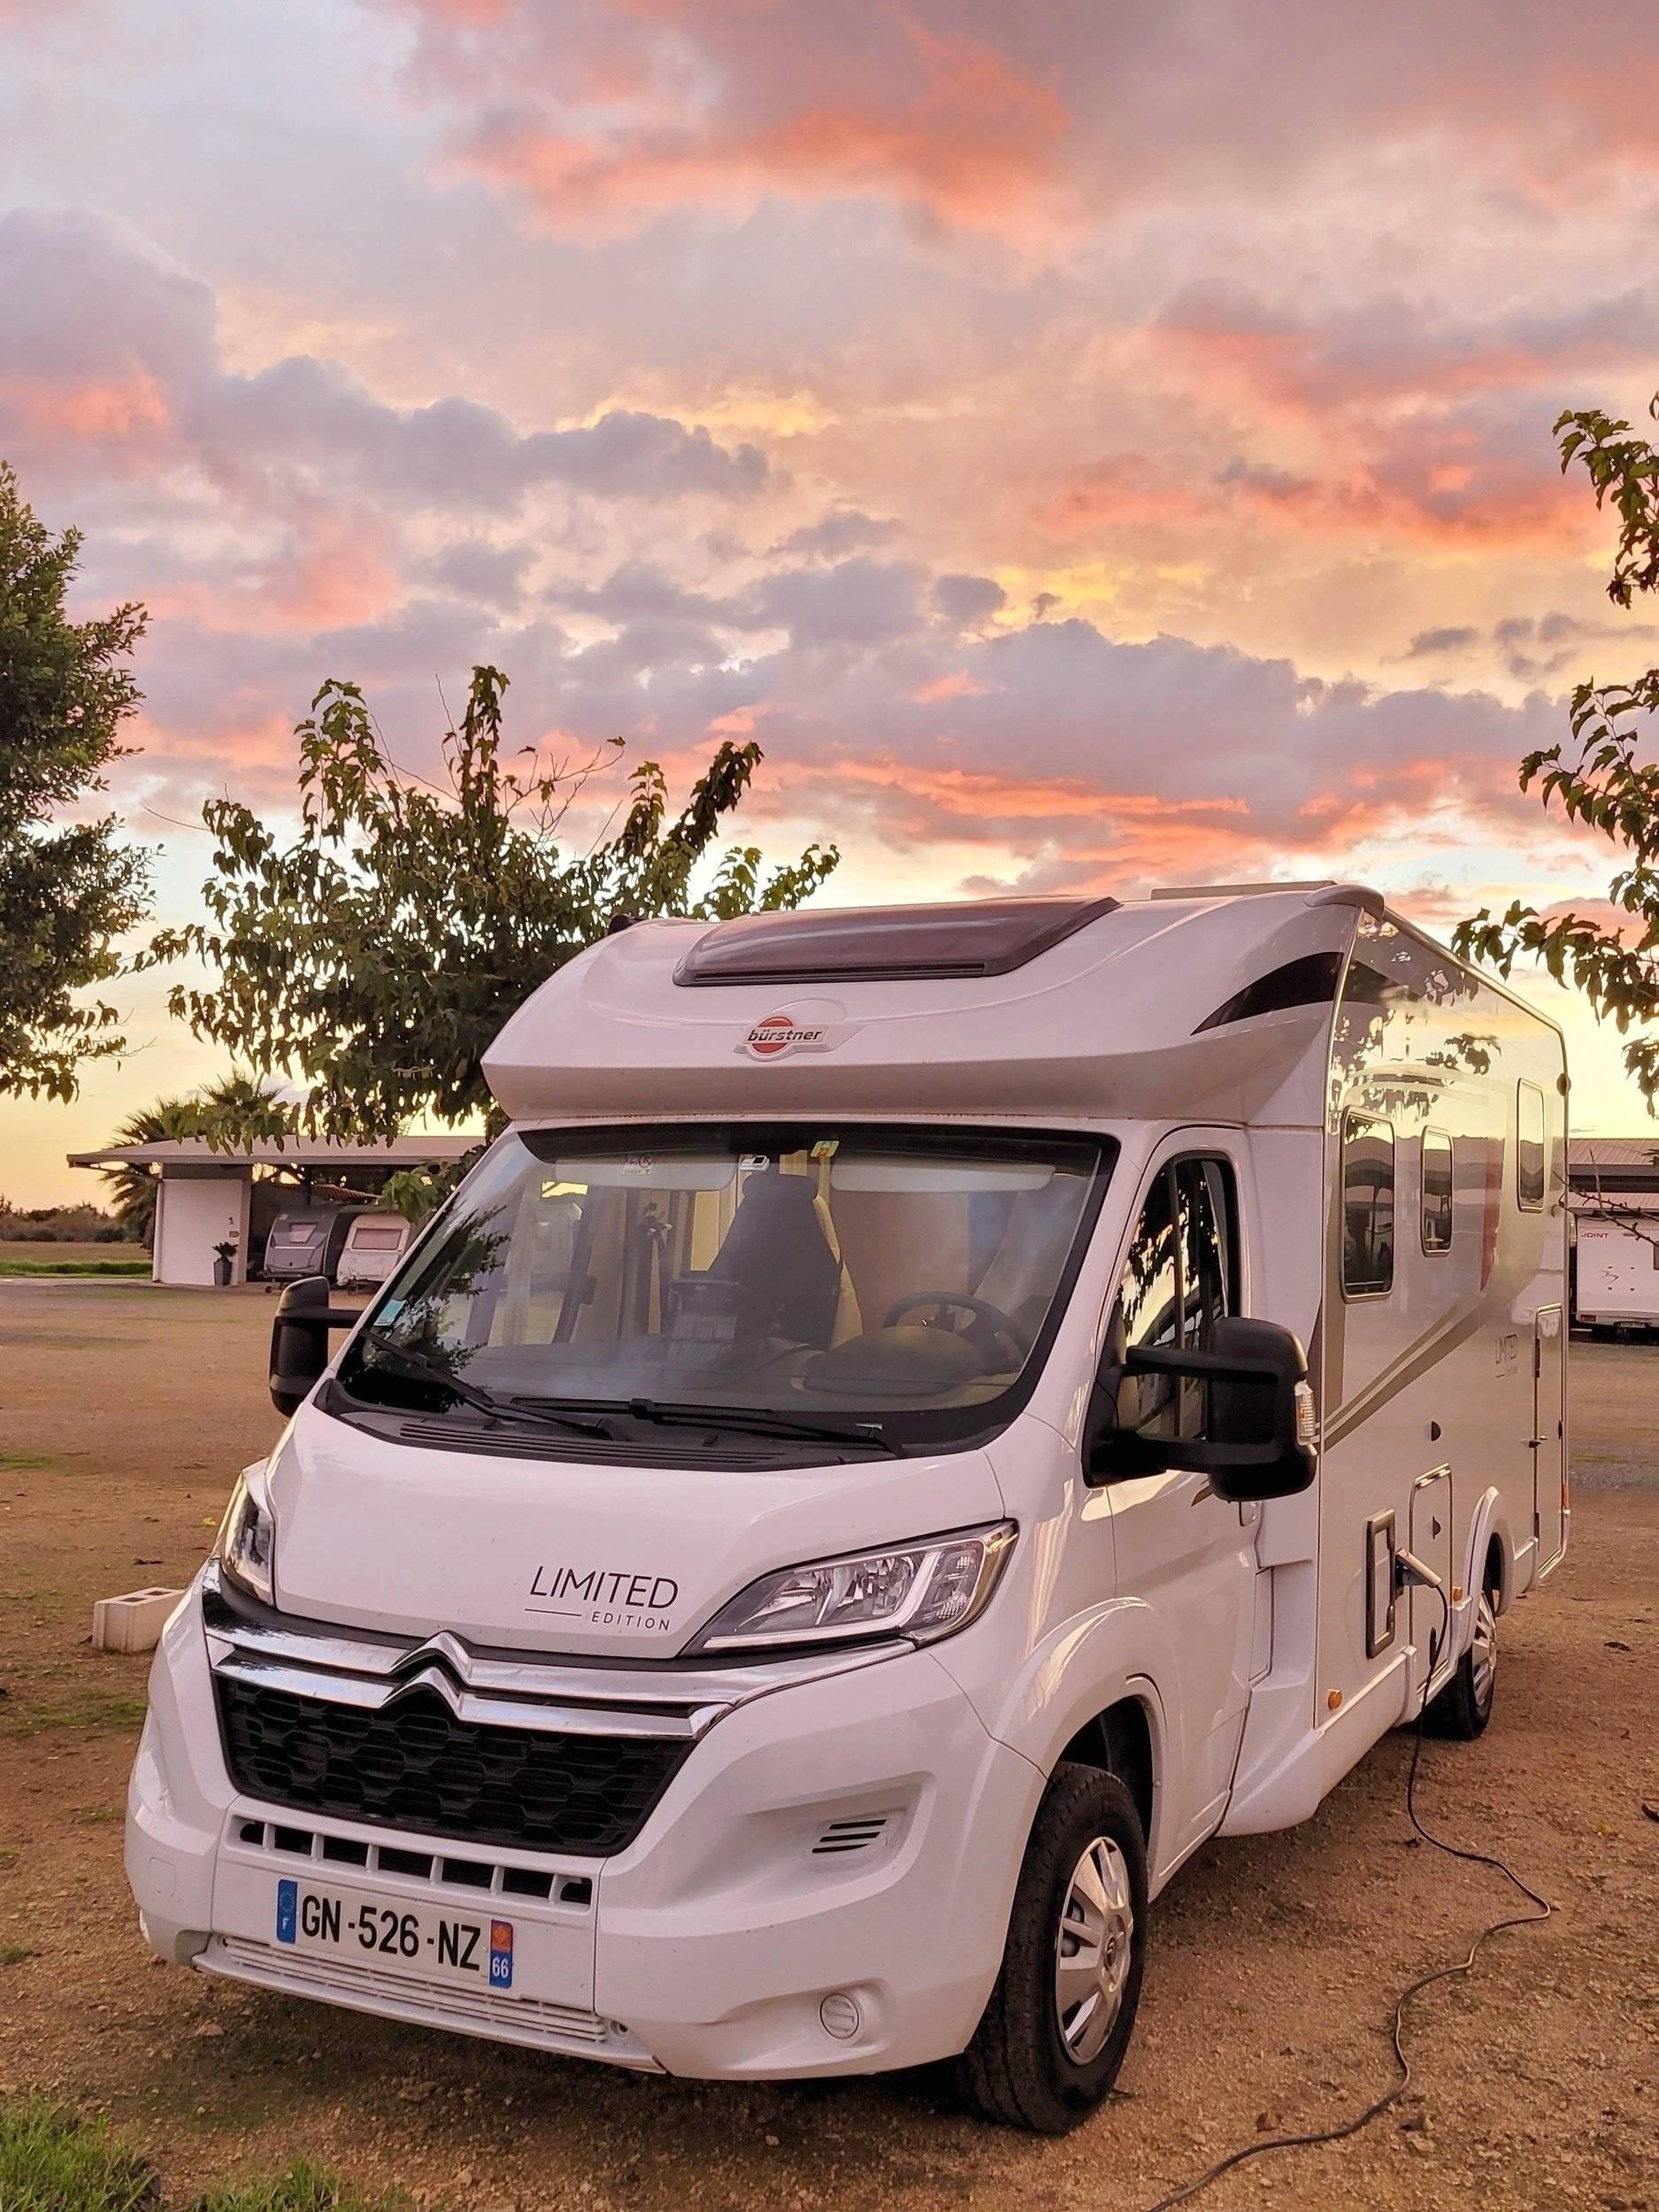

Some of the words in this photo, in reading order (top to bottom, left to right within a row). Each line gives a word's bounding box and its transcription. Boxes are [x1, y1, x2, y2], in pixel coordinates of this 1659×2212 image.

[747, 1028, 824, 1041] bürstner
[529, 1565, 680, 1609] LIMITED
[591, 1610, 672, 1632] EDITION
[281, 1916, 291, 1931] F
[491, 1956, 510, 1979] 66
